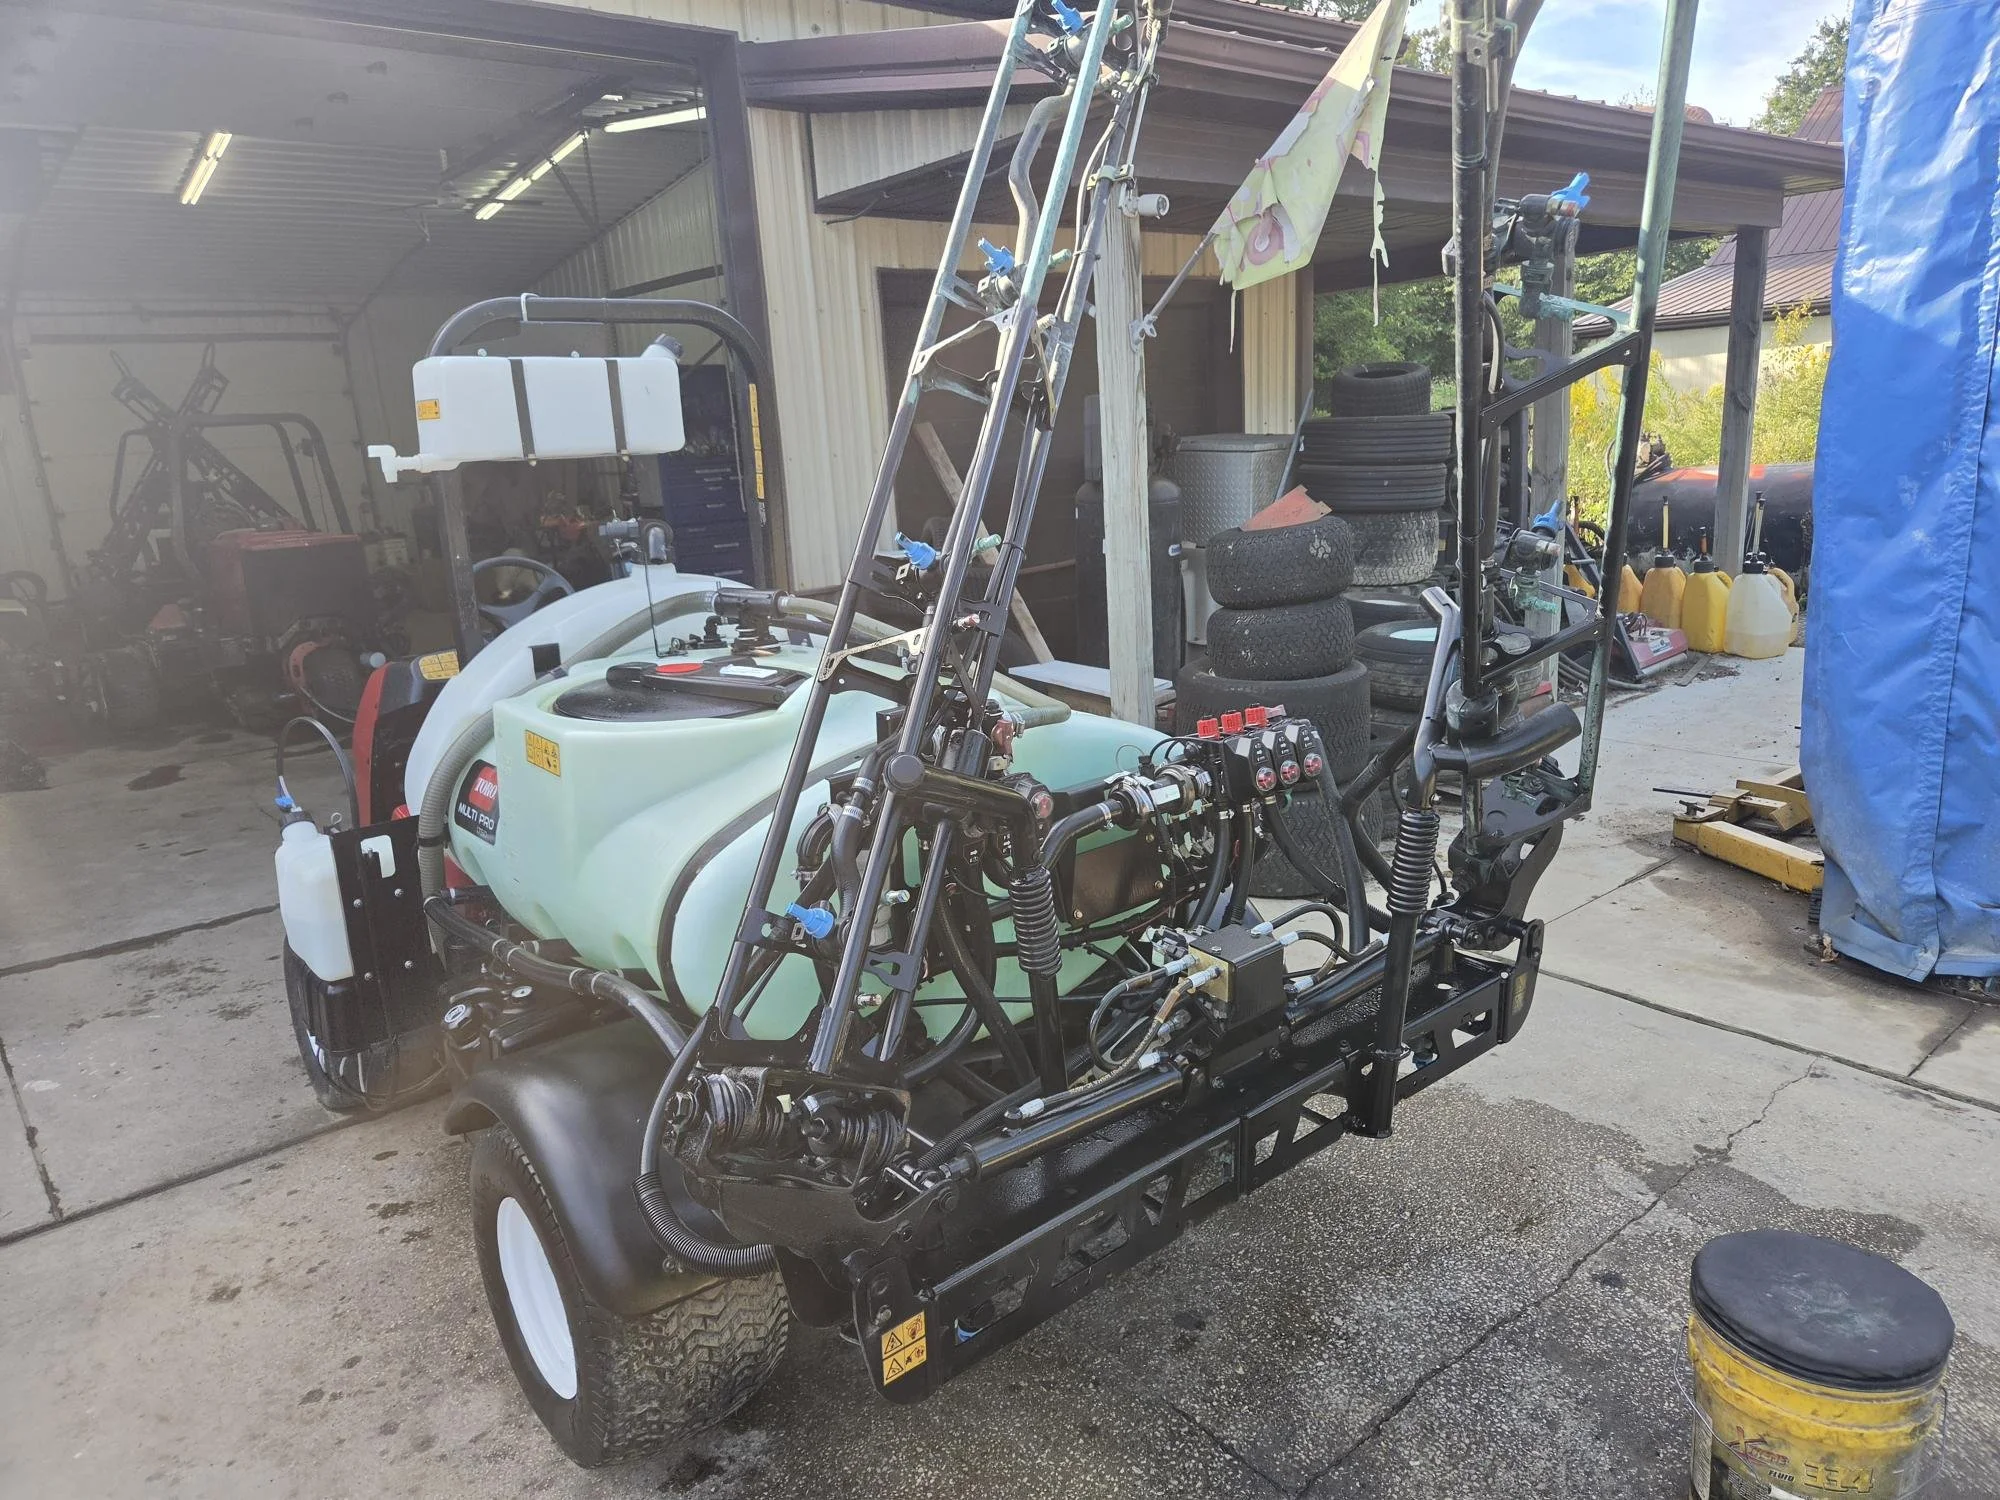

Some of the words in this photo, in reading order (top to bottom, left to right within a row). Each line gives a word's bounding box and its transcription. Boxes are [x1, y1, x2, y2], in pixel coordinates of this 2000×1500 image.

[474, 777, 497, 799] TORO
[458, 802, 478, 821] MULTI
[479, 813, 494, 830] PRO
[1768, 1469, 1795, 1482] FLUID
